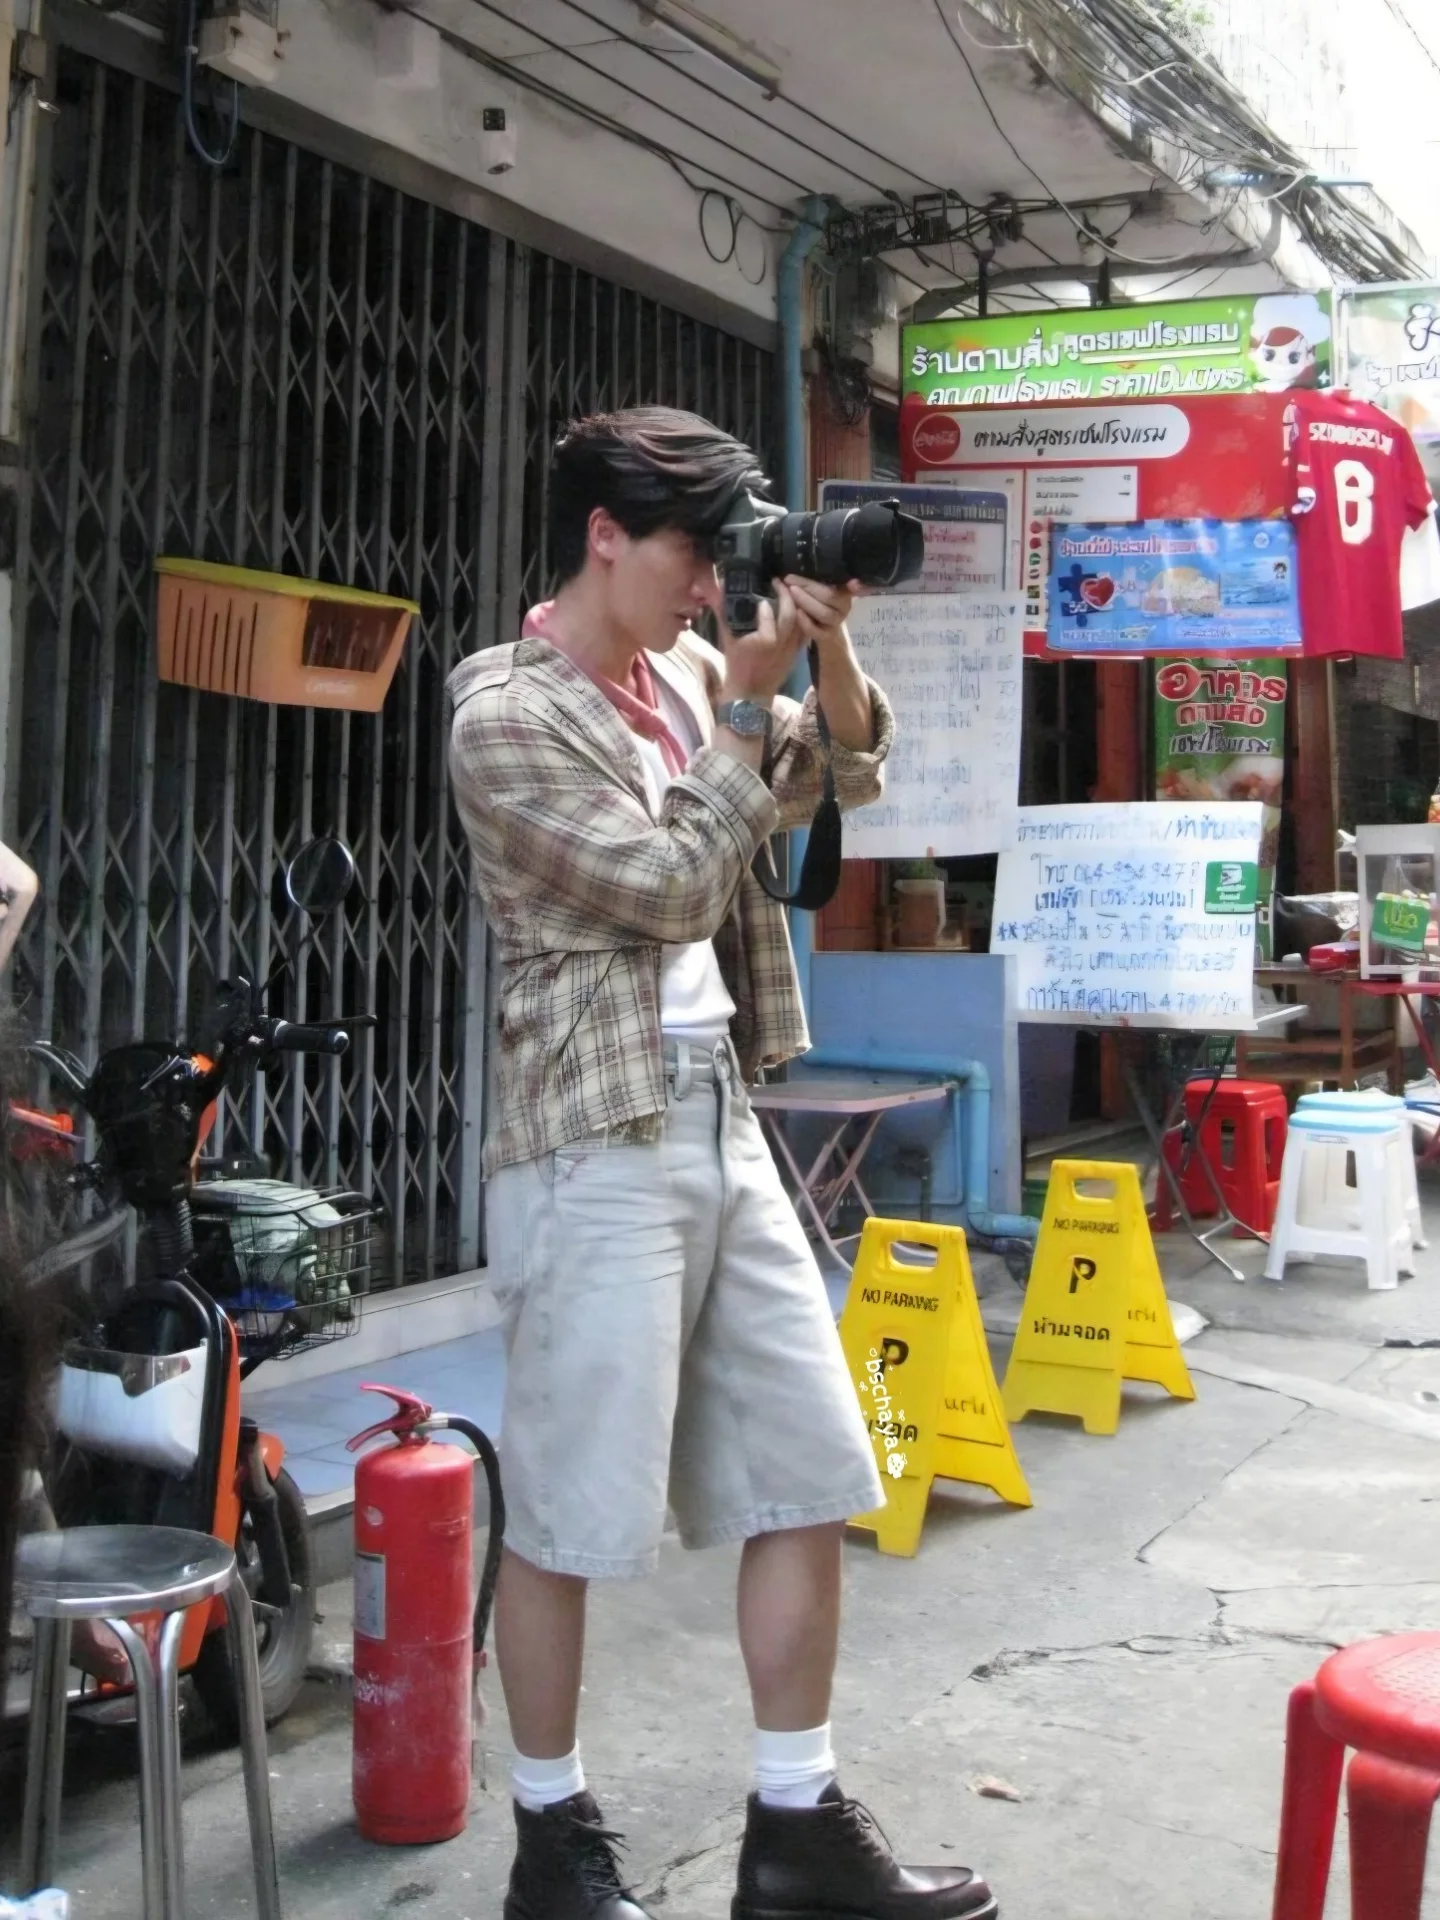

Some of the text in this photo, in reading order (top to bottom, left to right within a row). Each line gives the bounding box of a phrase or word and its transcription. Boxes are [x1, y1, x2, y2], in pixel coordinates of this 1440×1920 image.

[911, 326, 1061, 377] ร้านตามสั่ง
[926, 373, 1093, 406] คณภาพโรงแรม
[1334, 459, 1375, 545] 8
[1068, 1256, 1097, 1294] P
[861, 1288, 881, 1304] NO
[1033, 1316, 1110, 1341] ห้ามจอด
